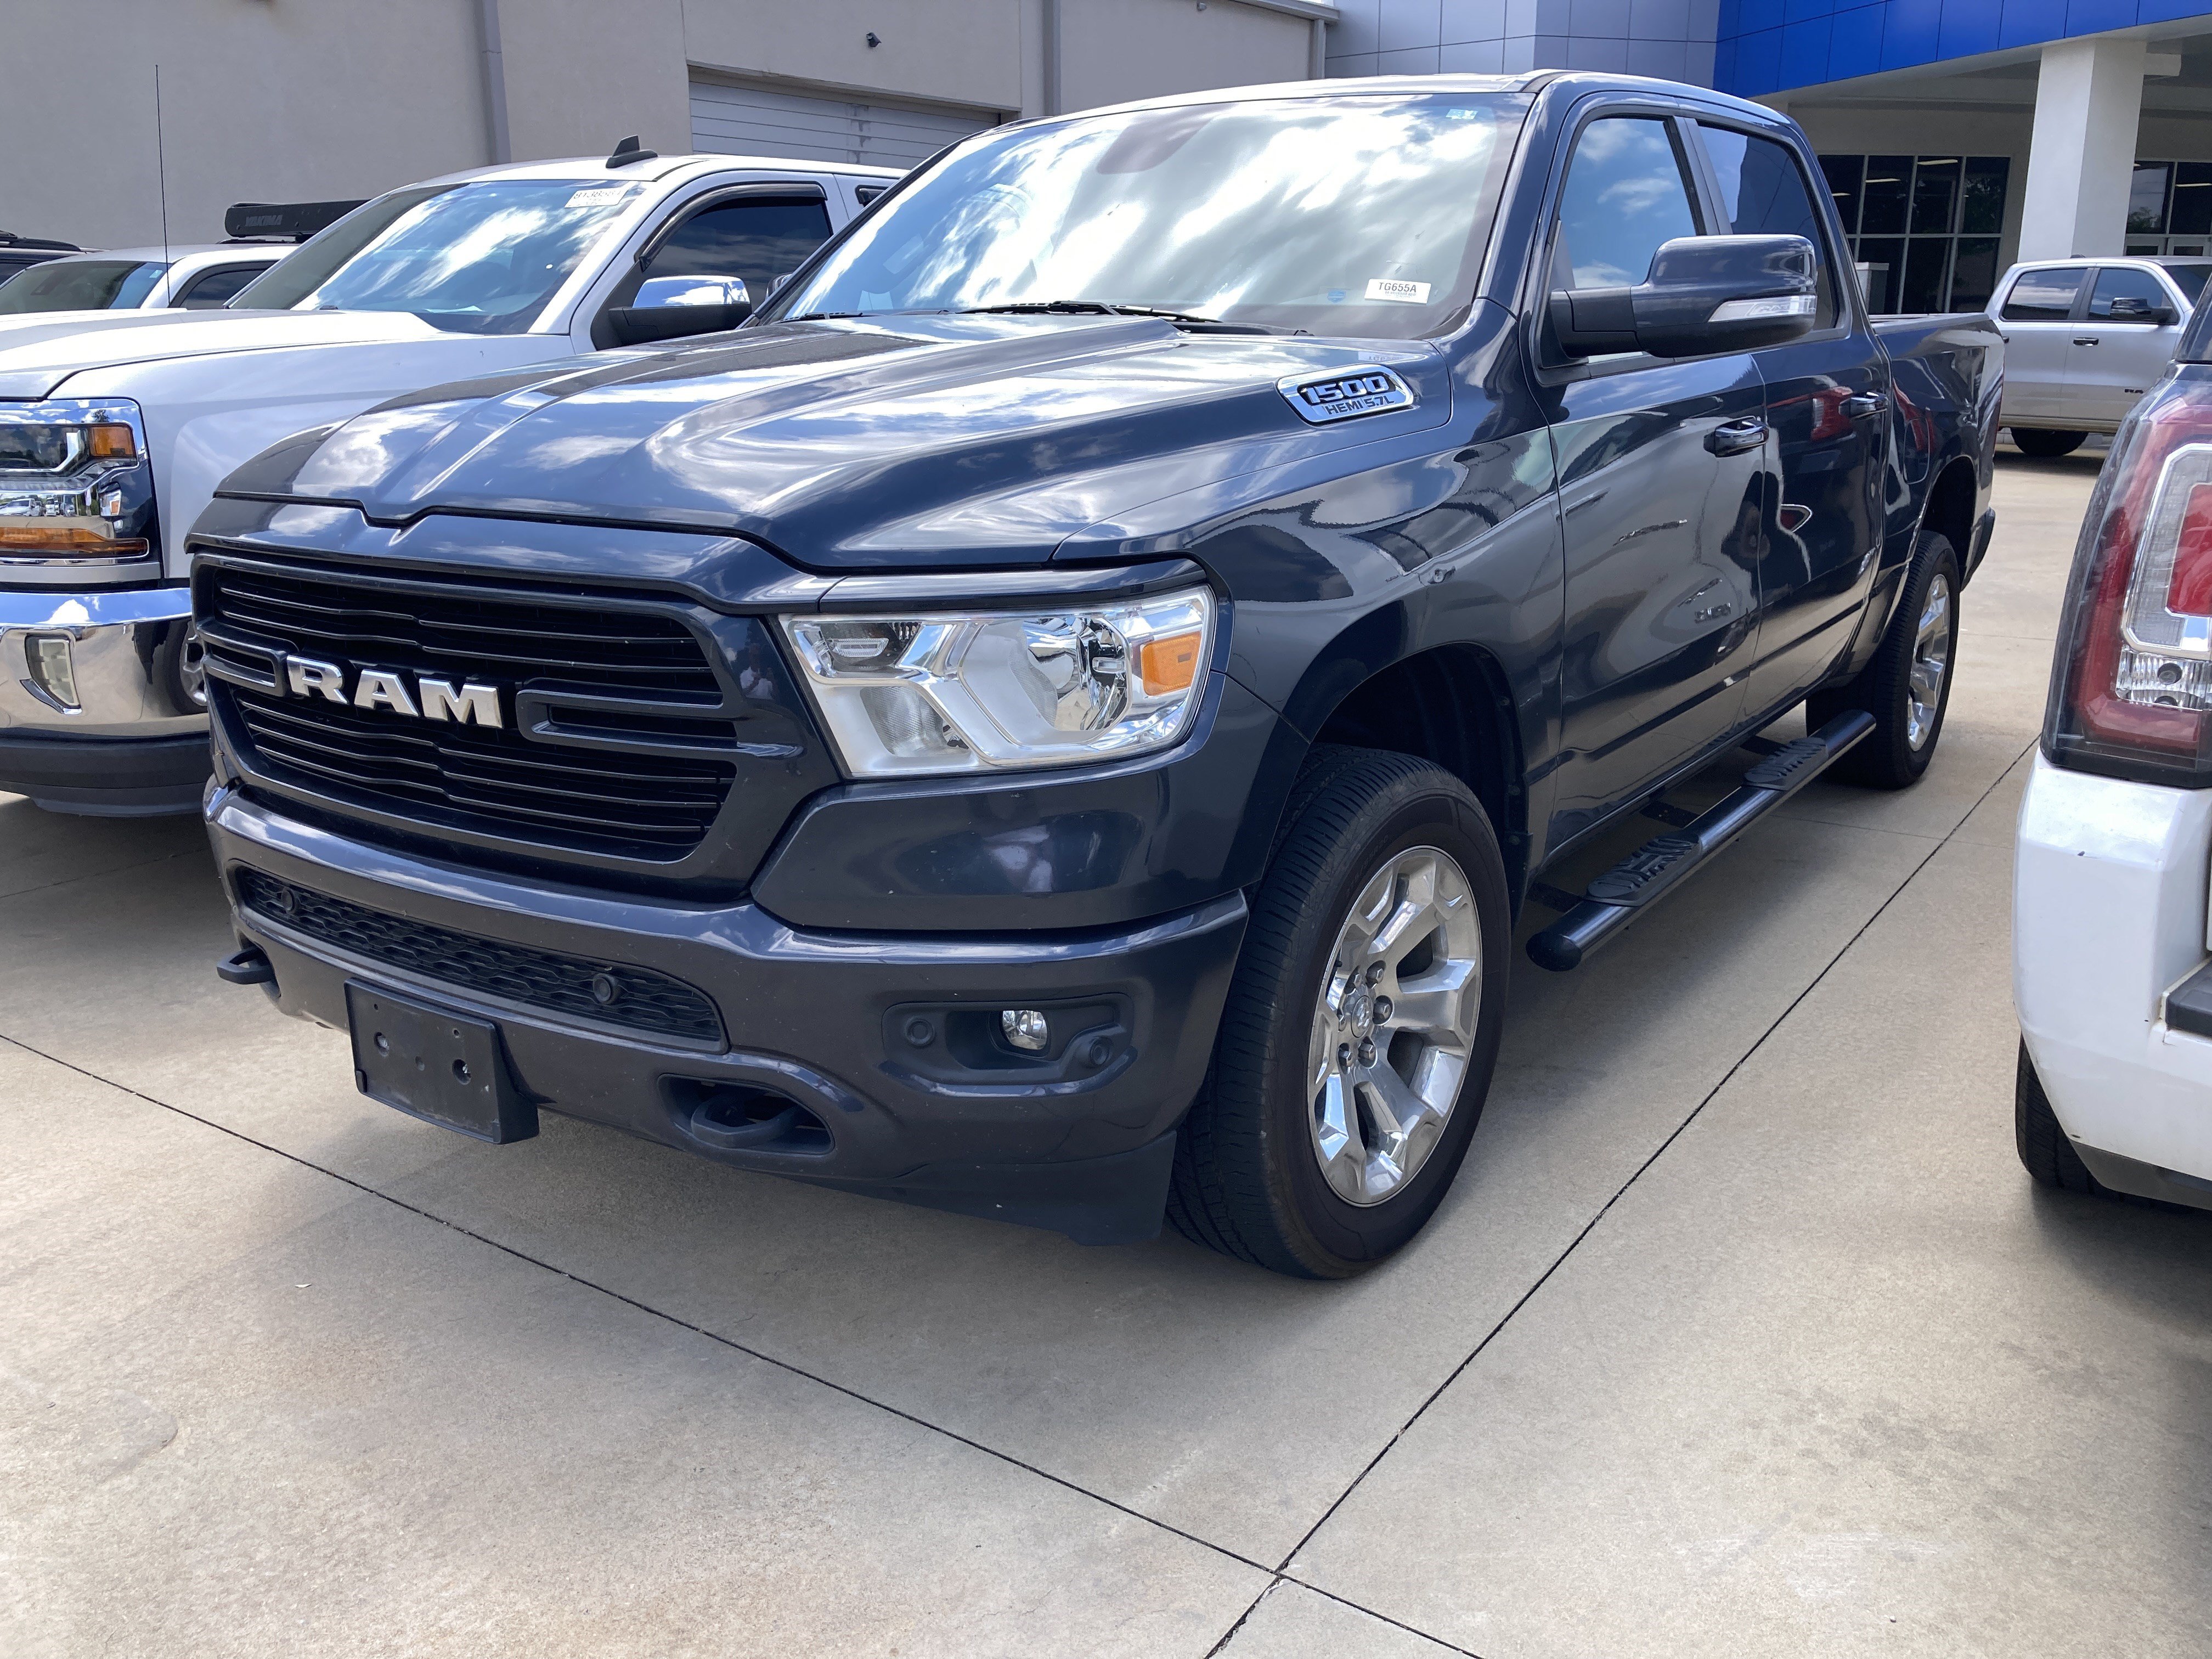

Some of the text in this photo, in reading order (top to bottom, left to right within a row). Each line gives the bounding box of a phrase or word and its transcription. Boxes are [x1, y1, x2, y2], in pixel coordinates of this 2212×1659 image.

[1379, 282, 1417, 293] TG655A
[1300, 375, 1390, 404] 1500
[1324, 395, 1395, 415] HEMI 5.7L
[286, 654, 504, 730] RAM
